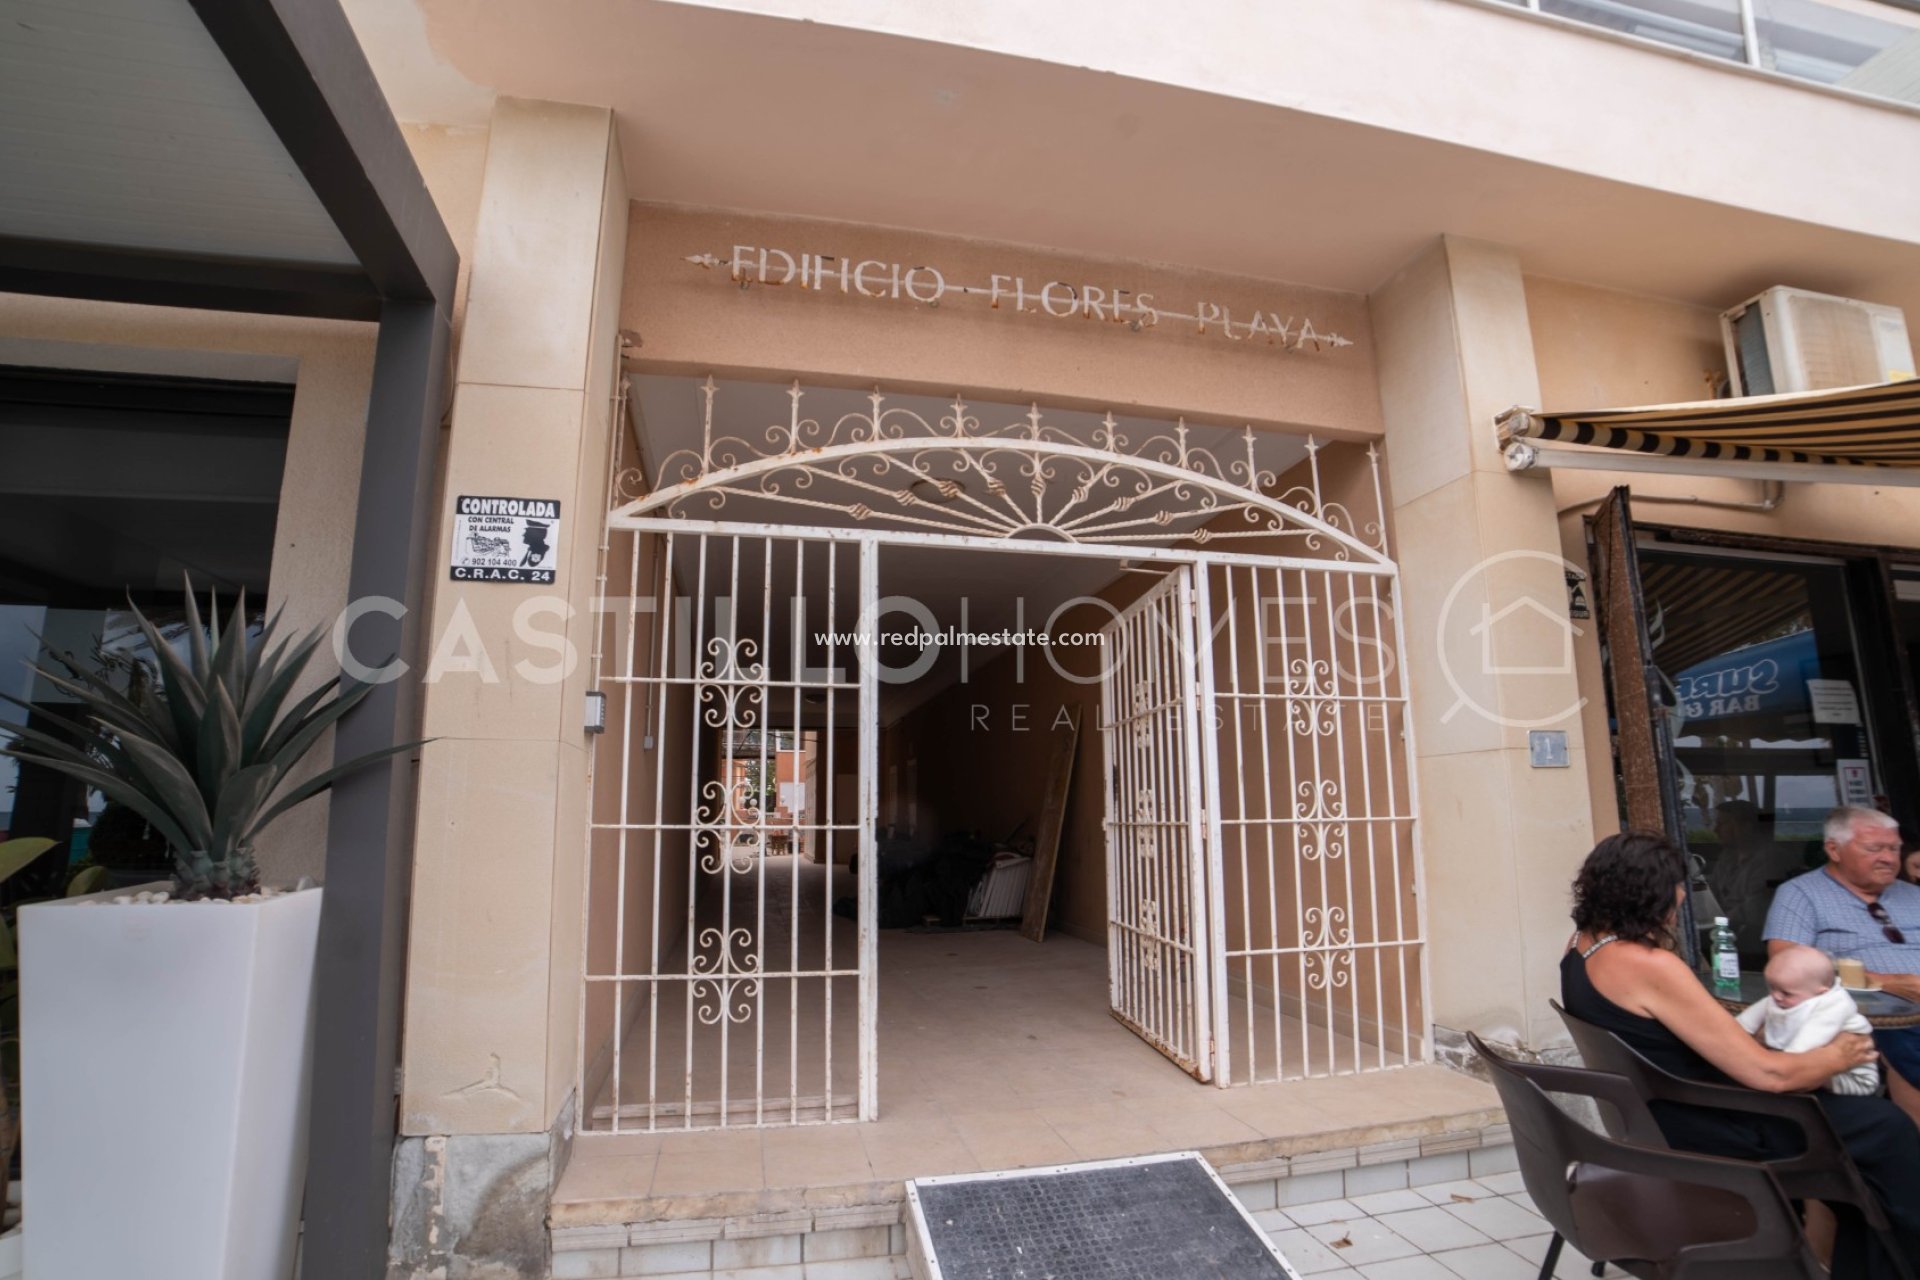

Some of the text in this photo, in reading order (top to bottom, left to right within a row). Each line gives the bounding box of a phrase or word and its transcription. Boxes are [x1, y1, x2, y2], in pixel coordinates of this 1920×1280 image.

[732, 246, 1320, 352] EDIFICIO FLORES PLAYA
[461, 498, 555, 517] CONTROLADA
[468, 516, 483, 524] CON
[479, 525, 511, 533] ALARMAS
[472, 558, 517, 567] 902 104 400
[455, 567, 551, 581] C.R.A.C. 24
